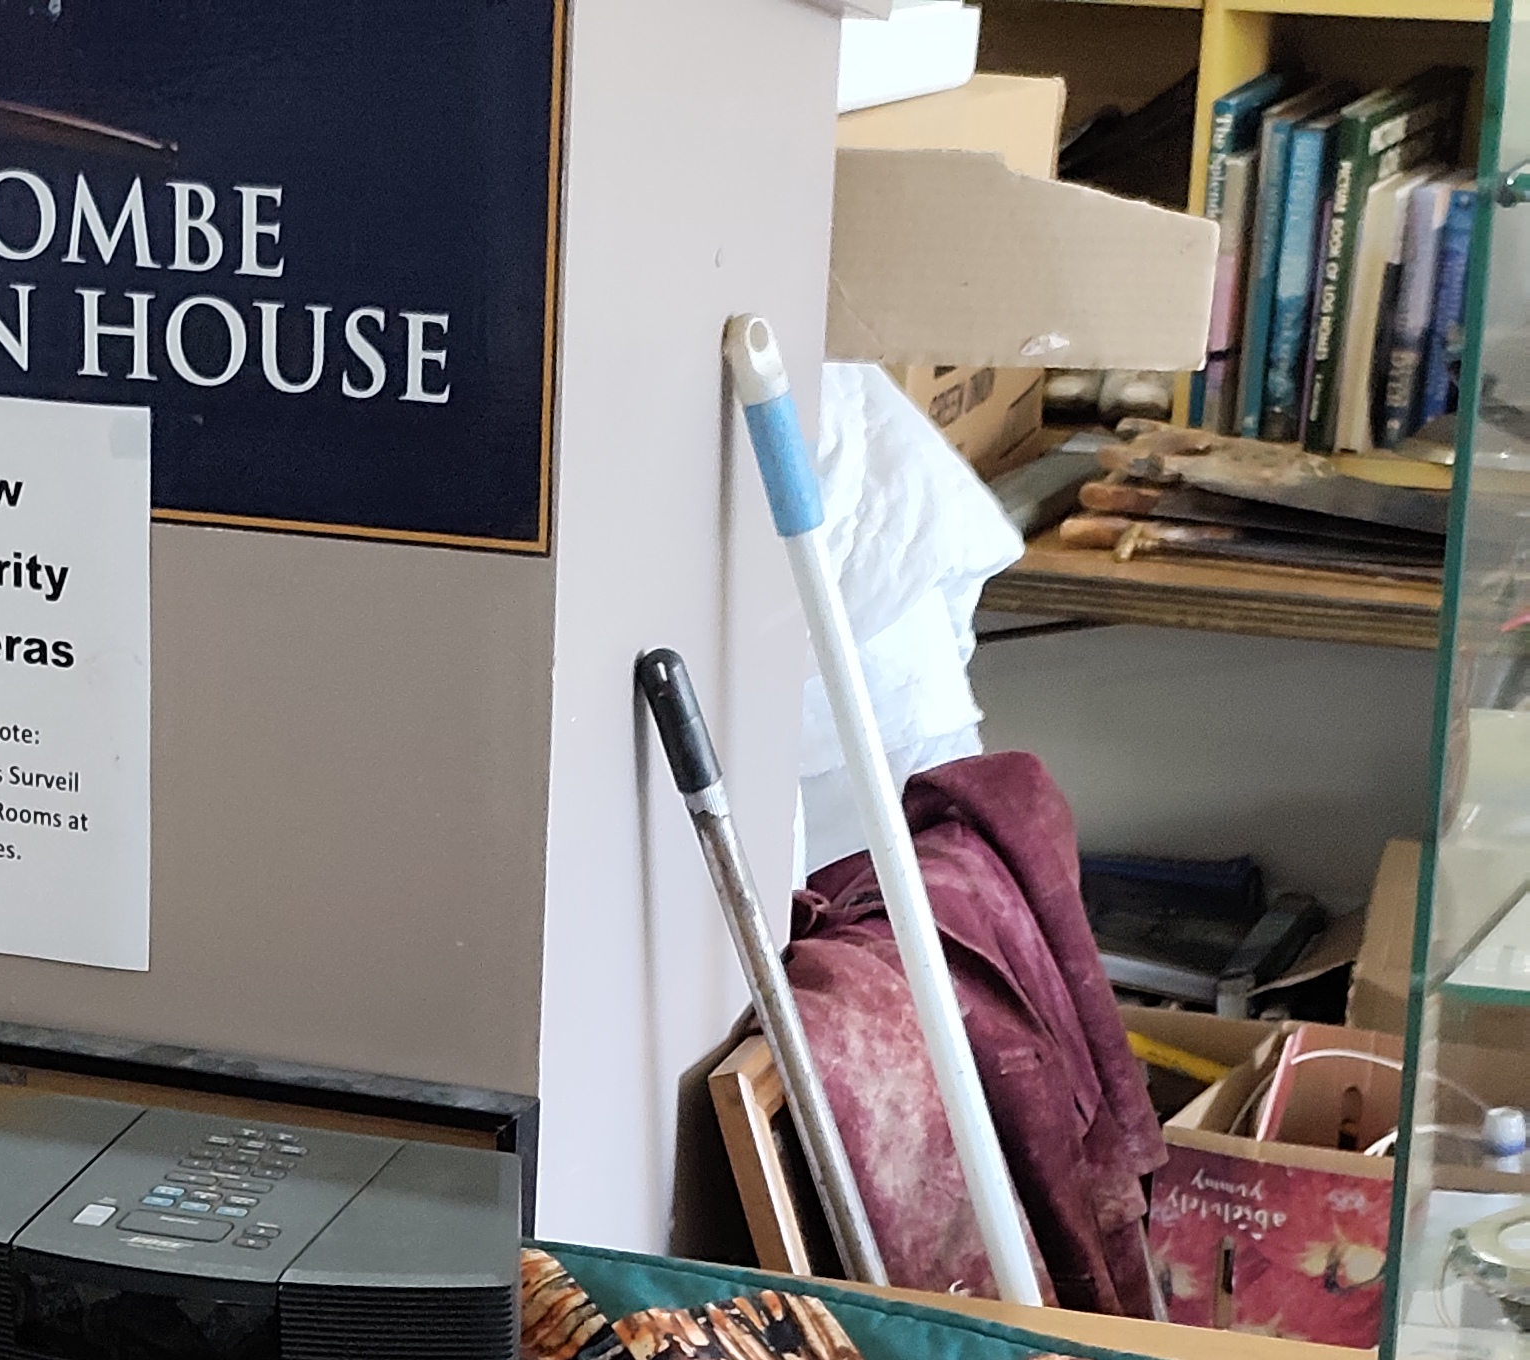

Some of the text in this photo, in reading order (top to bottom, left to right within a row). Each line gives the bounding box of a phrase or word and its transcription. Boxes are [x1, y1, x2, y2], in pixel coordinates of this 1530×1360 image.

[1205, 153, 1228, 220] Splend
[76, 287, 451, 404] HOUSE
[9, 766, 80, 793] Surveil
[68, 813, 89, 832] at
[1191, 1168, 1264, 1201] yummy
